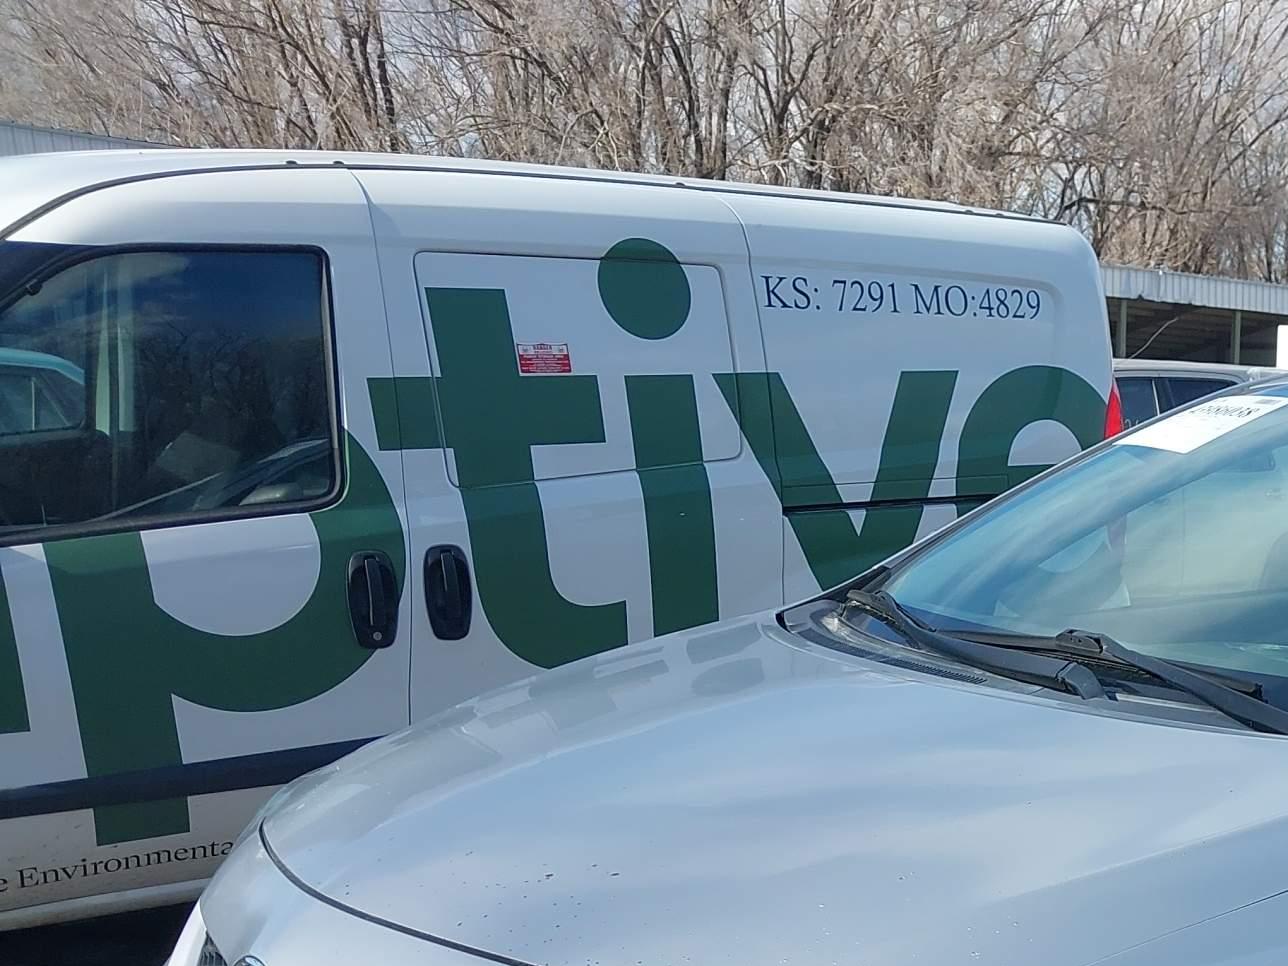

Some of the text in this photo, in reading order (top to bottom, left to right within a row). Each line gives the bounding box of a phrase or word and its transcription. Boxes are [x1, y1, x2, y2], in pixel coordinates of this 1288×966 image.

[760, 274, 1041, 320] KS: 7291 MO:4829
[0, 238, 1110, 846] ptive
